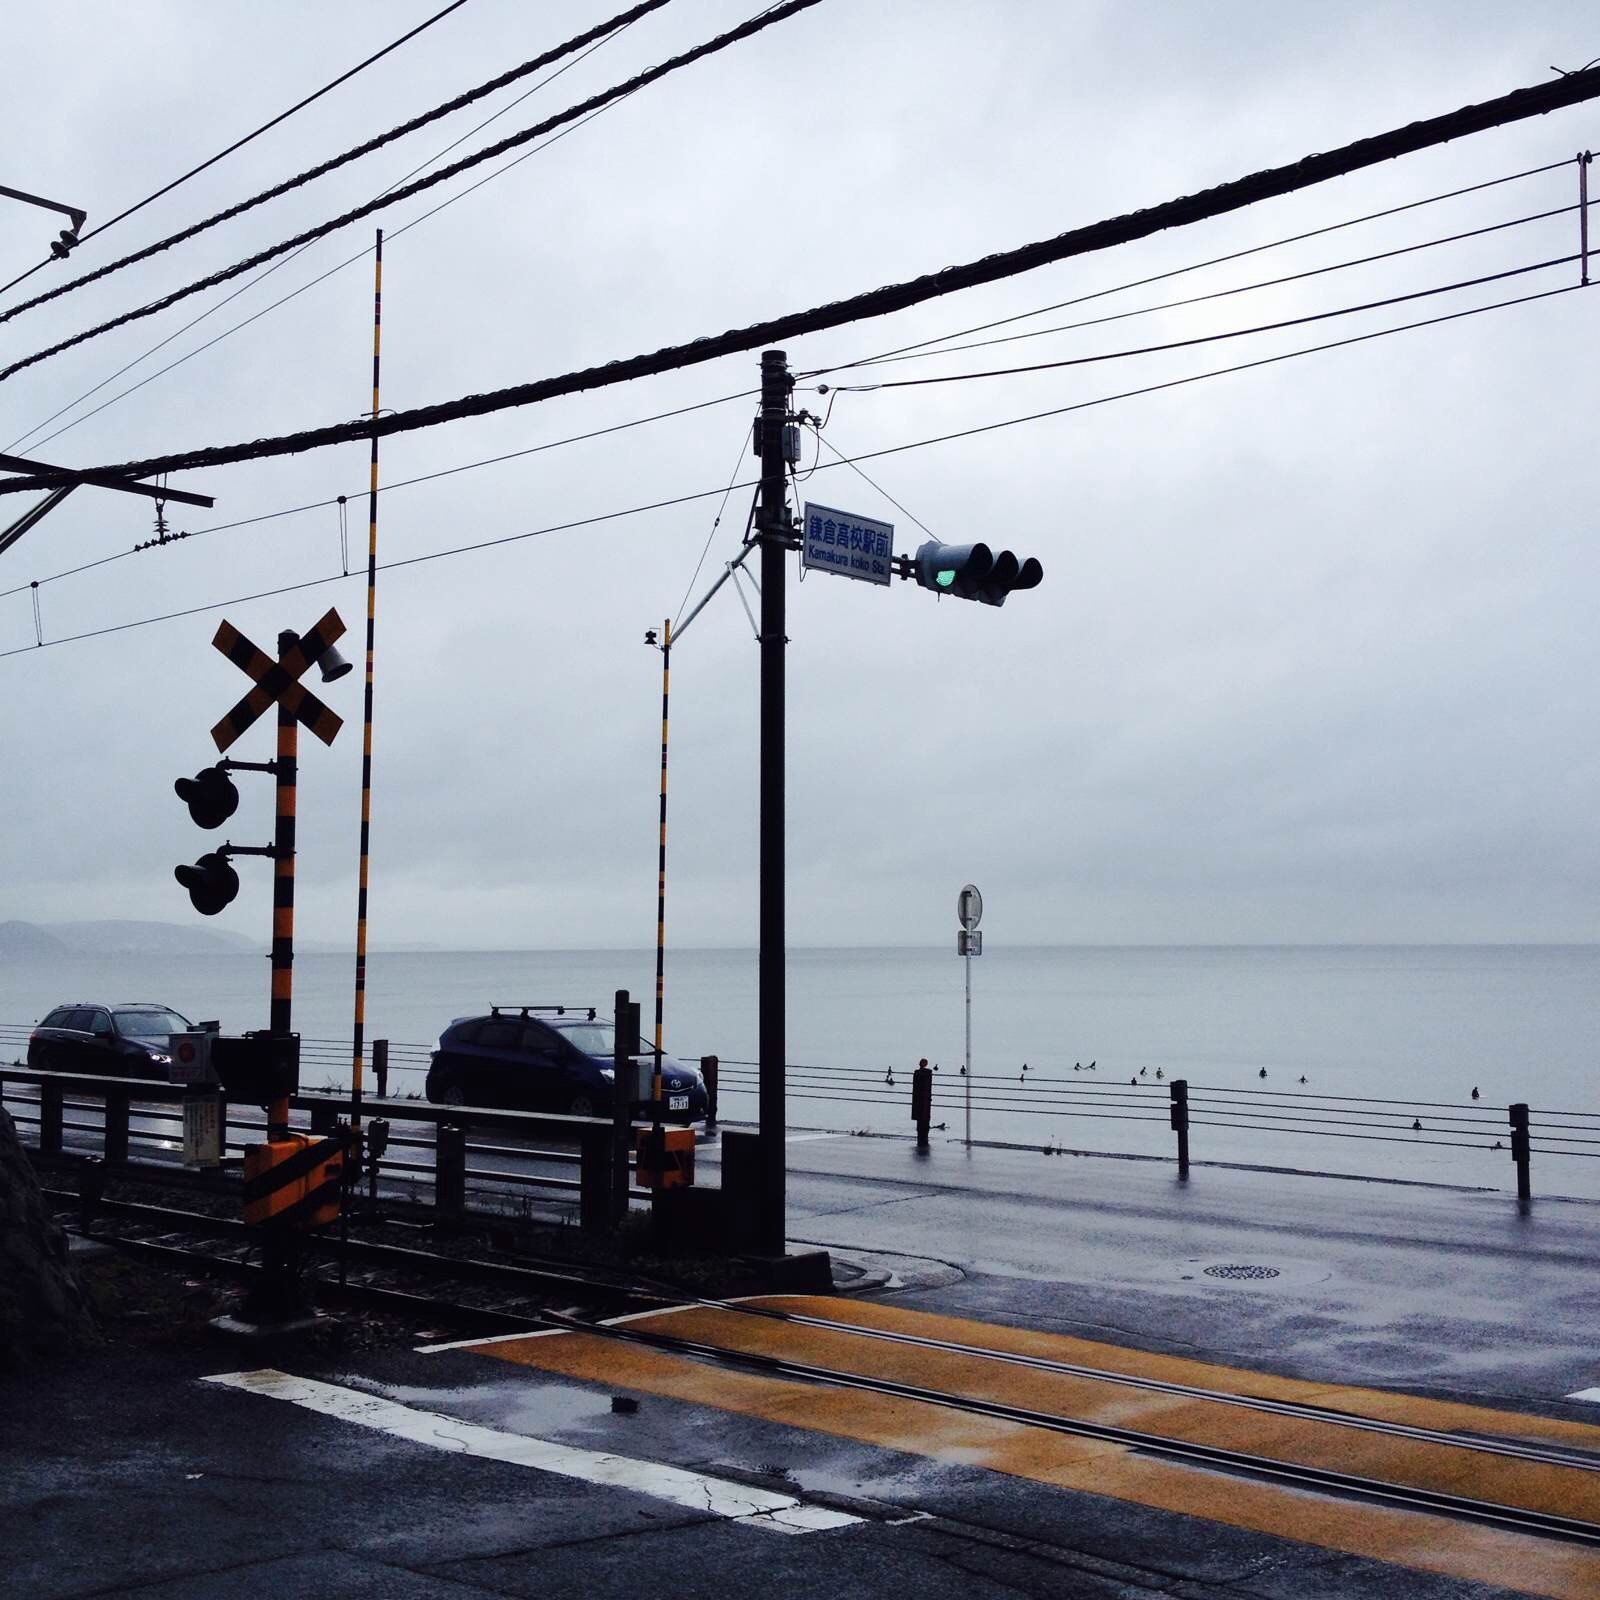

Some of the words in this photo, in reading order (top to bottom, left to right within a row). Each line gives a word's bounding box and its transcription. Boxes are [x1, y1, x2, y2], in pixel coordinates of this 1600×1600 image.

[809, 515, 888, 557] 鎌倉高校駅前
[809, 544, 848, 566] Kamakura
